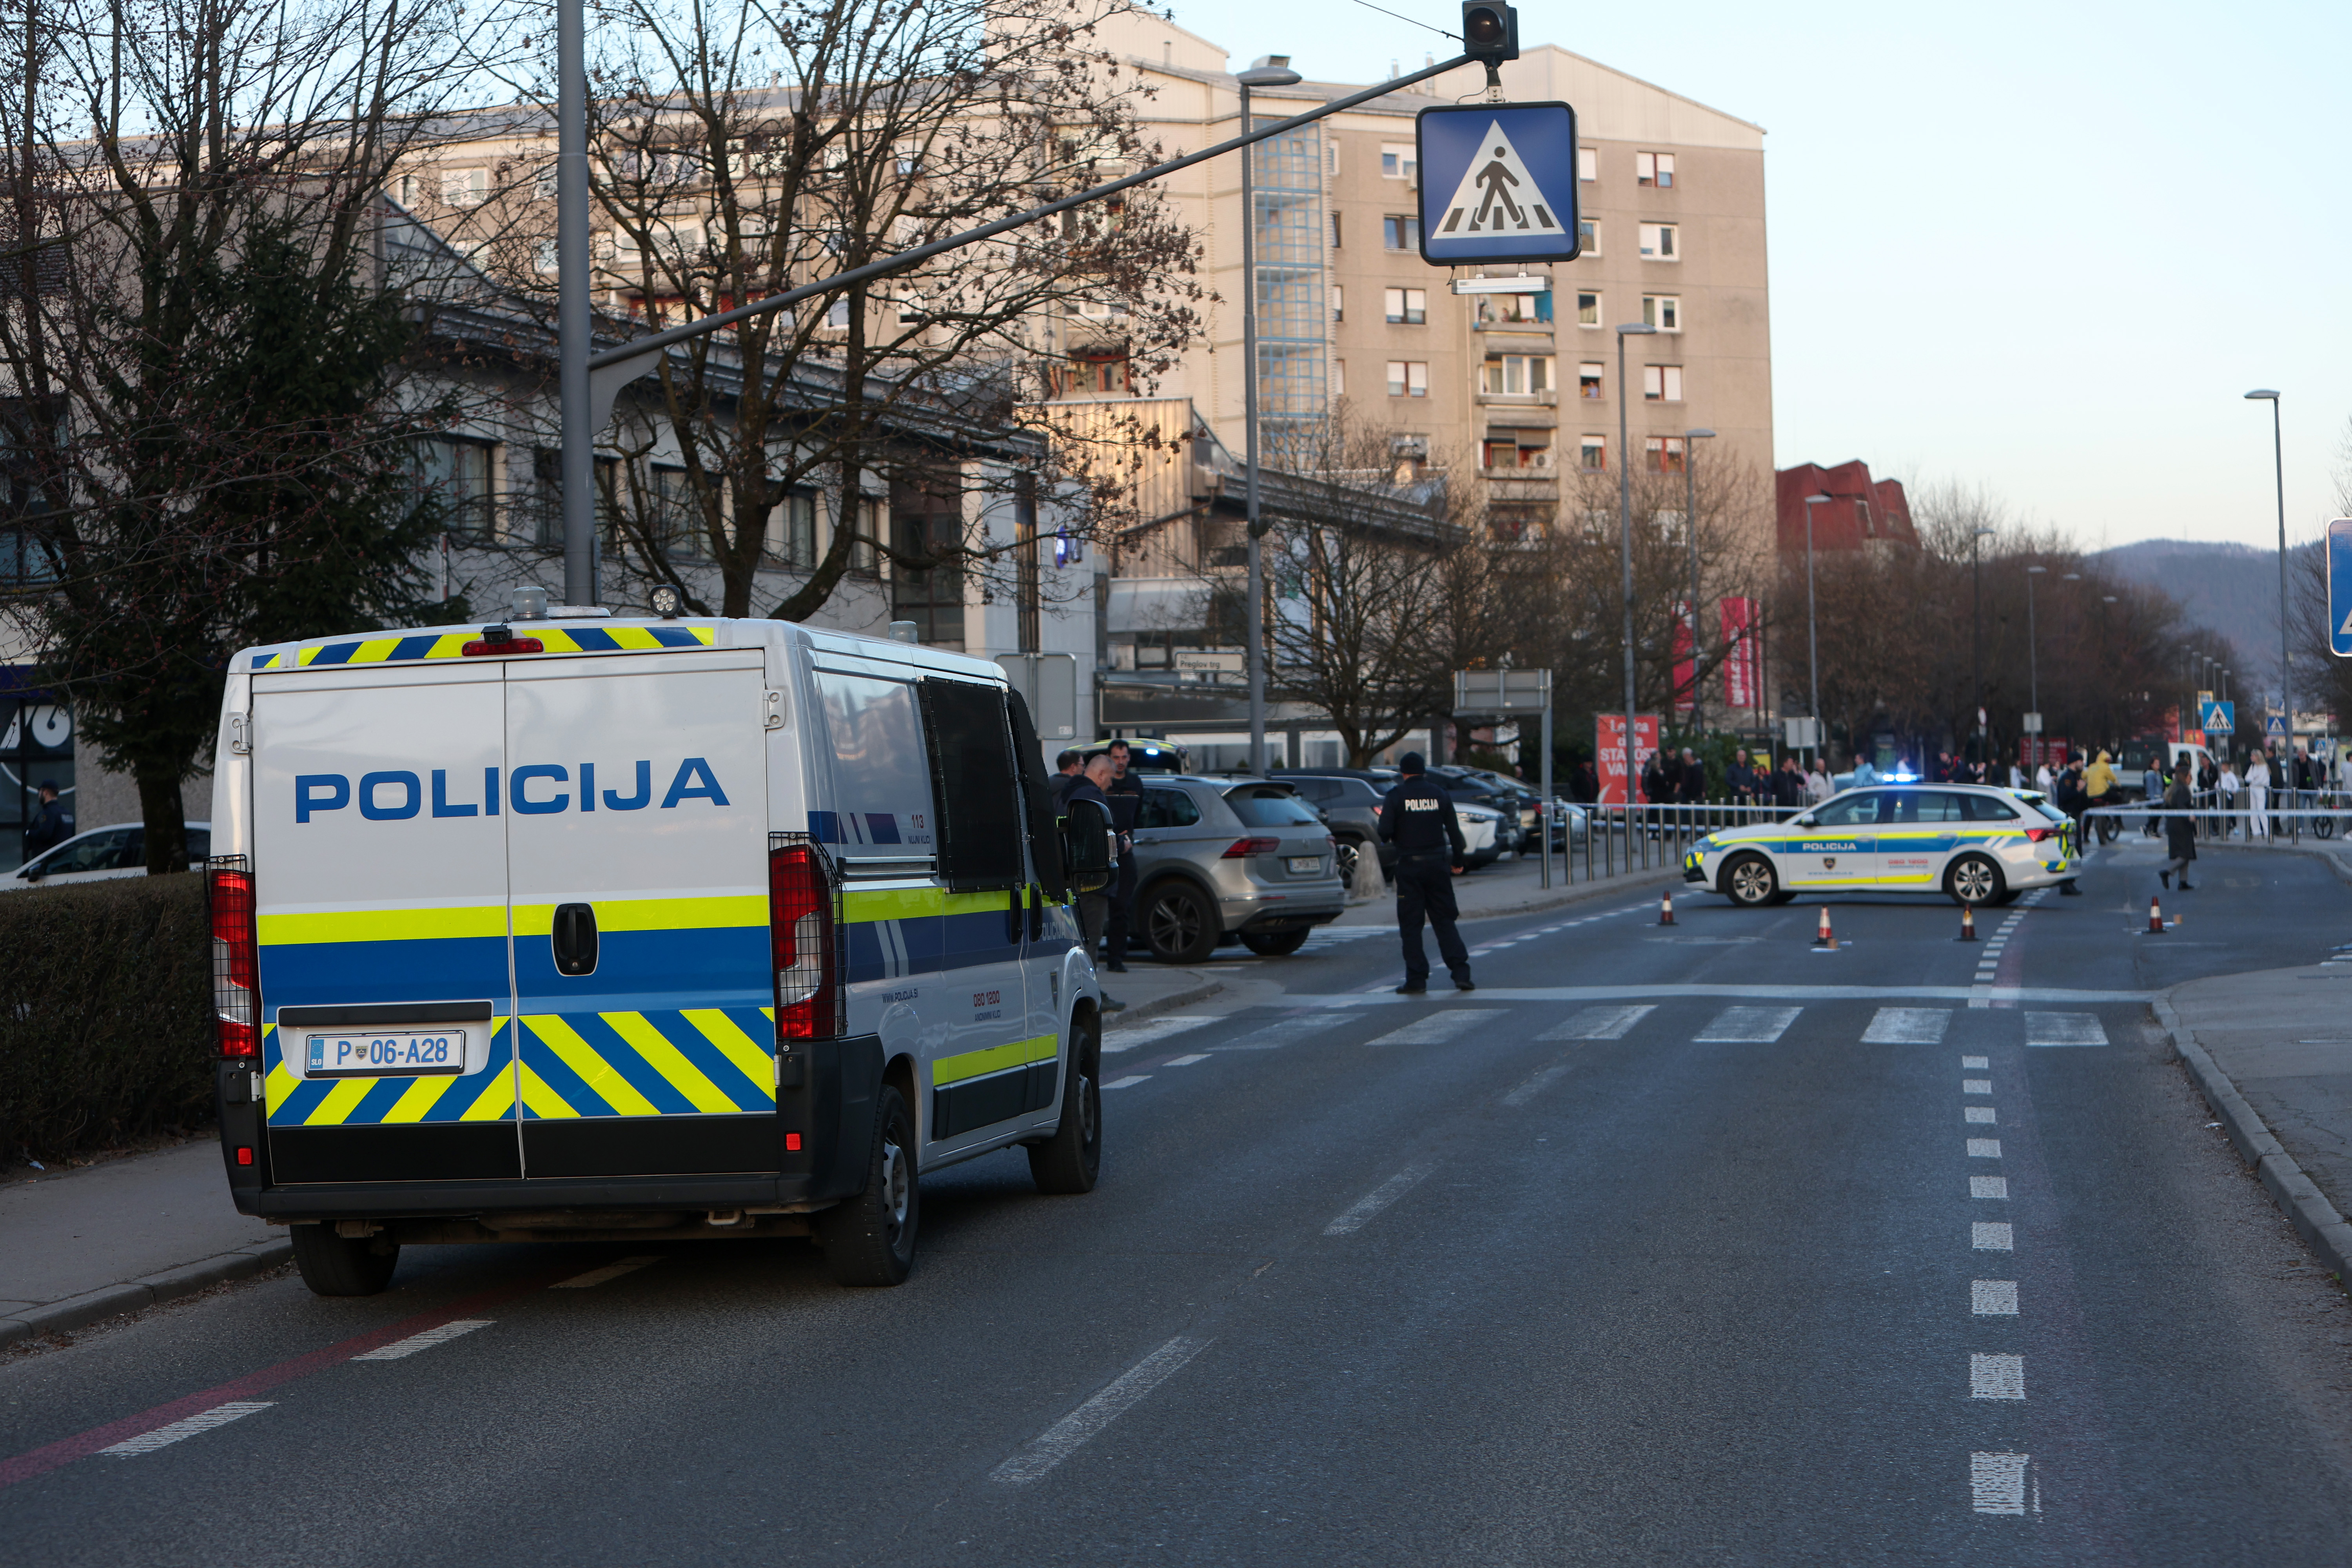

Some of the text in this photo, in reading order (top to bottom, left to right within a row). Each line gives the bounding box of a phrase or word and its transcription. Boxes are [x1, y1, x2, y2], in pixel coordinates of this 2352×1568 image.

[1180, 660, 1207, 669] Preglov
[1600, 747, 1658, 762] STAOST
[296, 757, 731, 824] POLICIJA
[1405, 799, 1439, 811] POLICIJA
[911, 814, 924, 829] 113
[1802, 842, 1857, 851] POLICIJA
[1038, 921, 1065, 942] OLICIJA
[973, 990, 1000, 1007] 080 1200
[337, 1037, 448, 1065] P 06-A28
